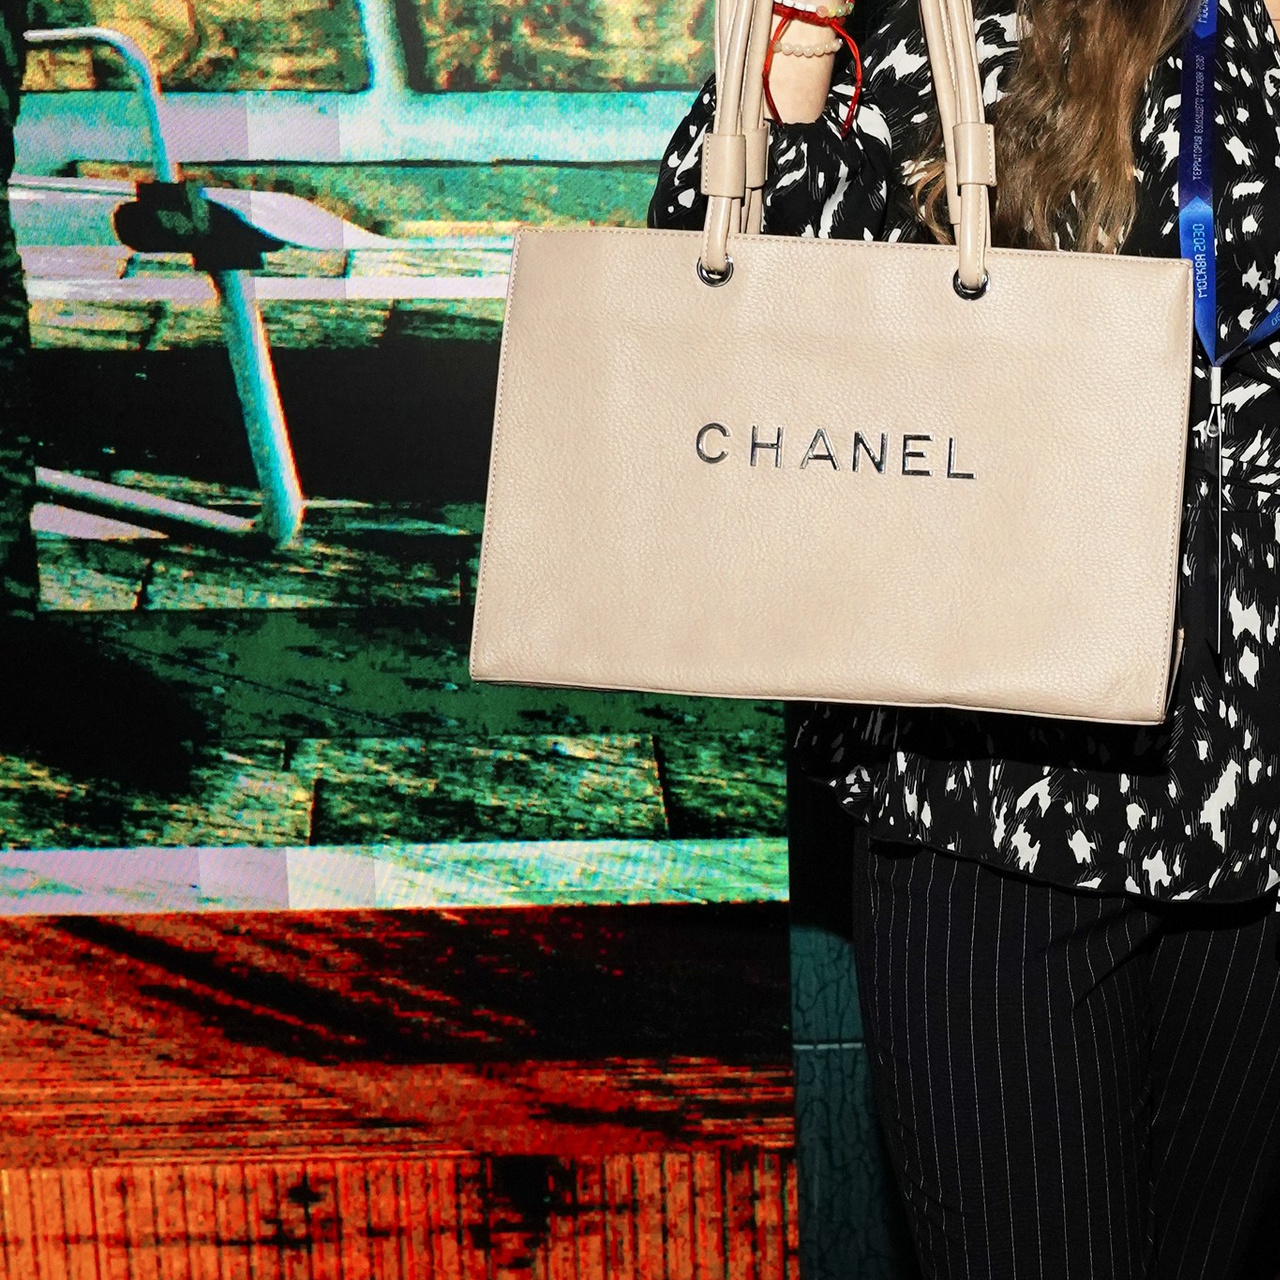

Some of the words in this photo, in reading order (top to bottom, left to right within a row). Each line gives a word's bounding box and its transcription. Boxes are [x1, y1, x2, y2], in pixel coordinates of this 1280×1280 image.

[1192, 223, 1206, 252] 2030
[1195, 253, 1208, 298] МОСКВА
[695, 422, 978, 480] CHANEL
